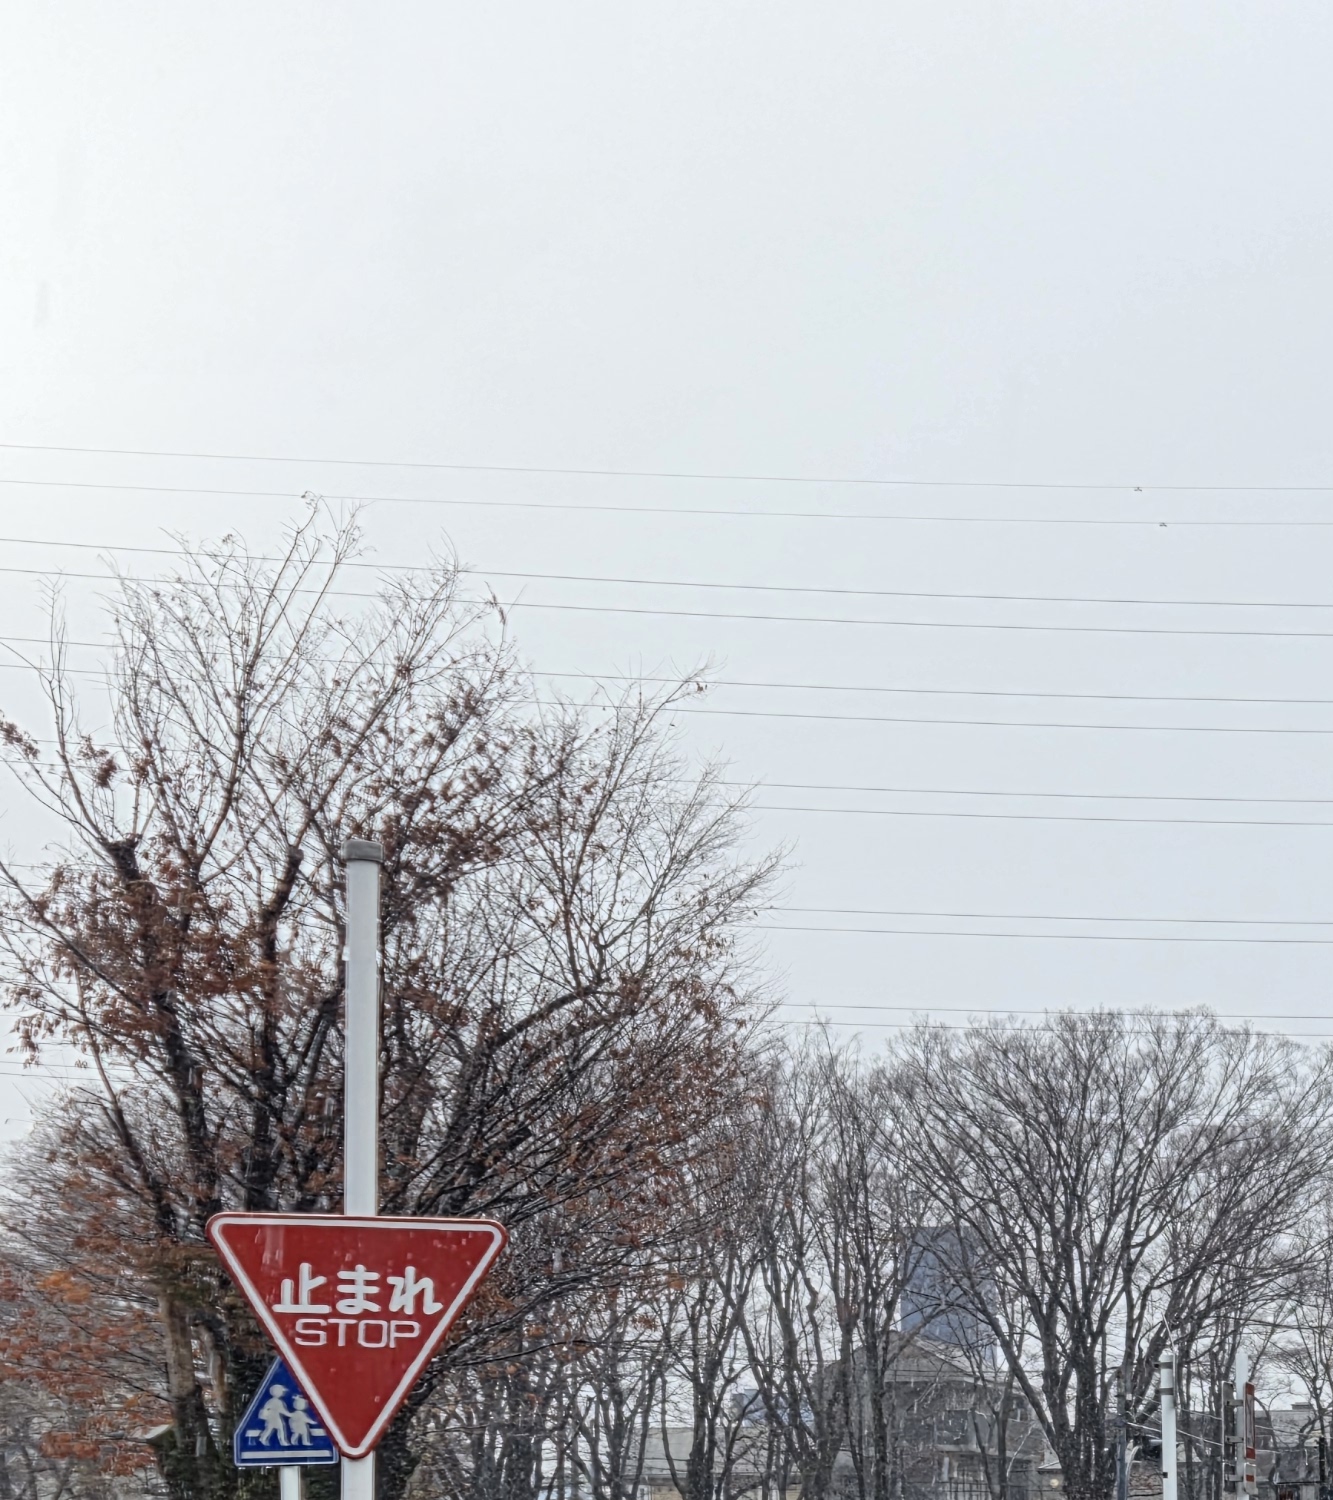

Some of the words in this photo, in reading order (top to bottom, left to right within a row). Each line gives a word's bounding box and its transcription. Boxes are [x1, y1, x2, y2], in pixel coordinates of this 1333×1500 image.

[272, 1262, 444, 1315] 止まれ
[295, 1318, 421, 1348] STOP
